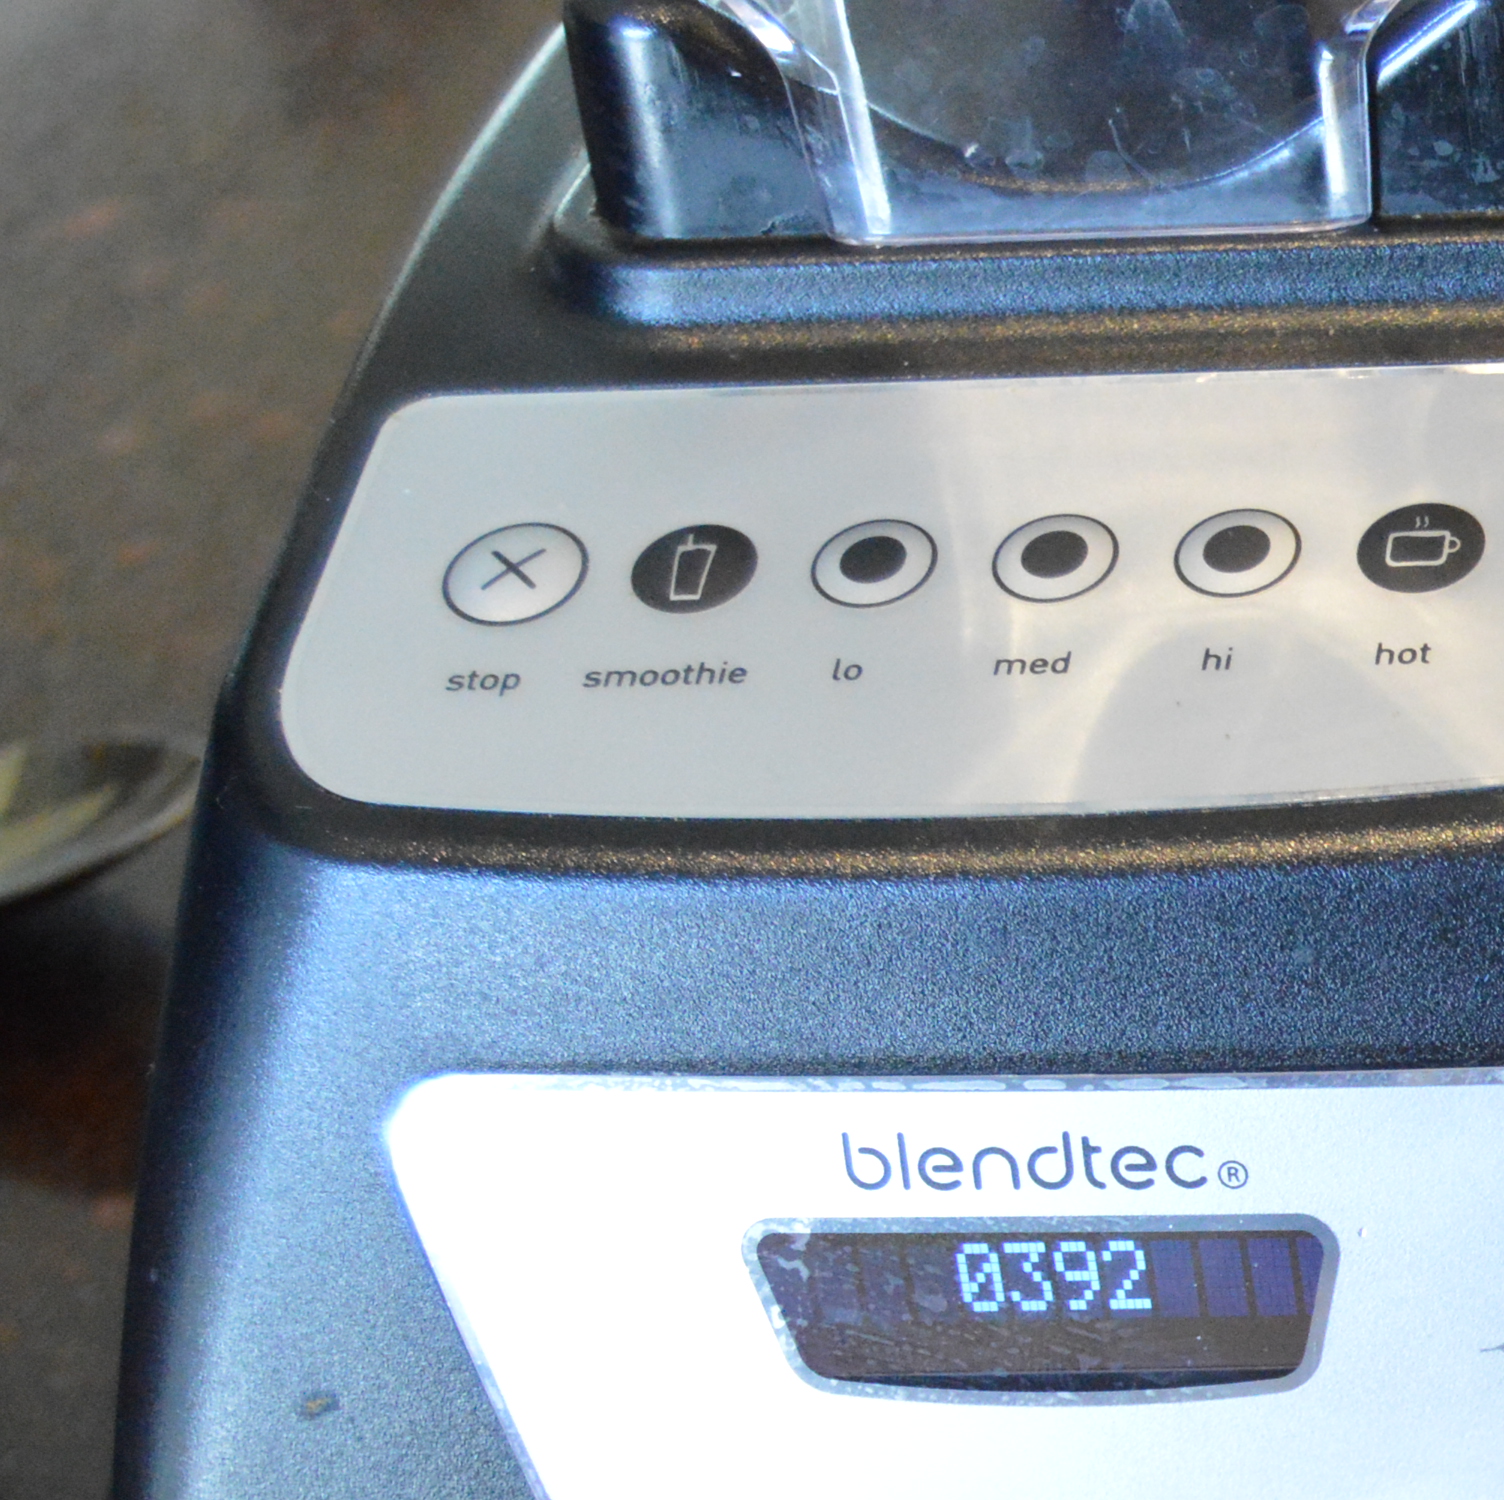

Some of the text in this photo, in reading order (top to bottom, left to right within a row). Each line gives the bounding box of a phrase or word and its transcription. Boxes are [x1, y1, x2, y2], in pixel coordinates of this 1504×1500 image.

[993, 651, 1071, 676] med
[1201, 646, 1233, 671] hi
[1374, 641, 1432, 667] hot
[446, 668, 520, 696] stop
[582, 660, 747, 689] smoothie
[831, 658, 863, 682] lo
[955, 1238, 1153, 1313] 0392
